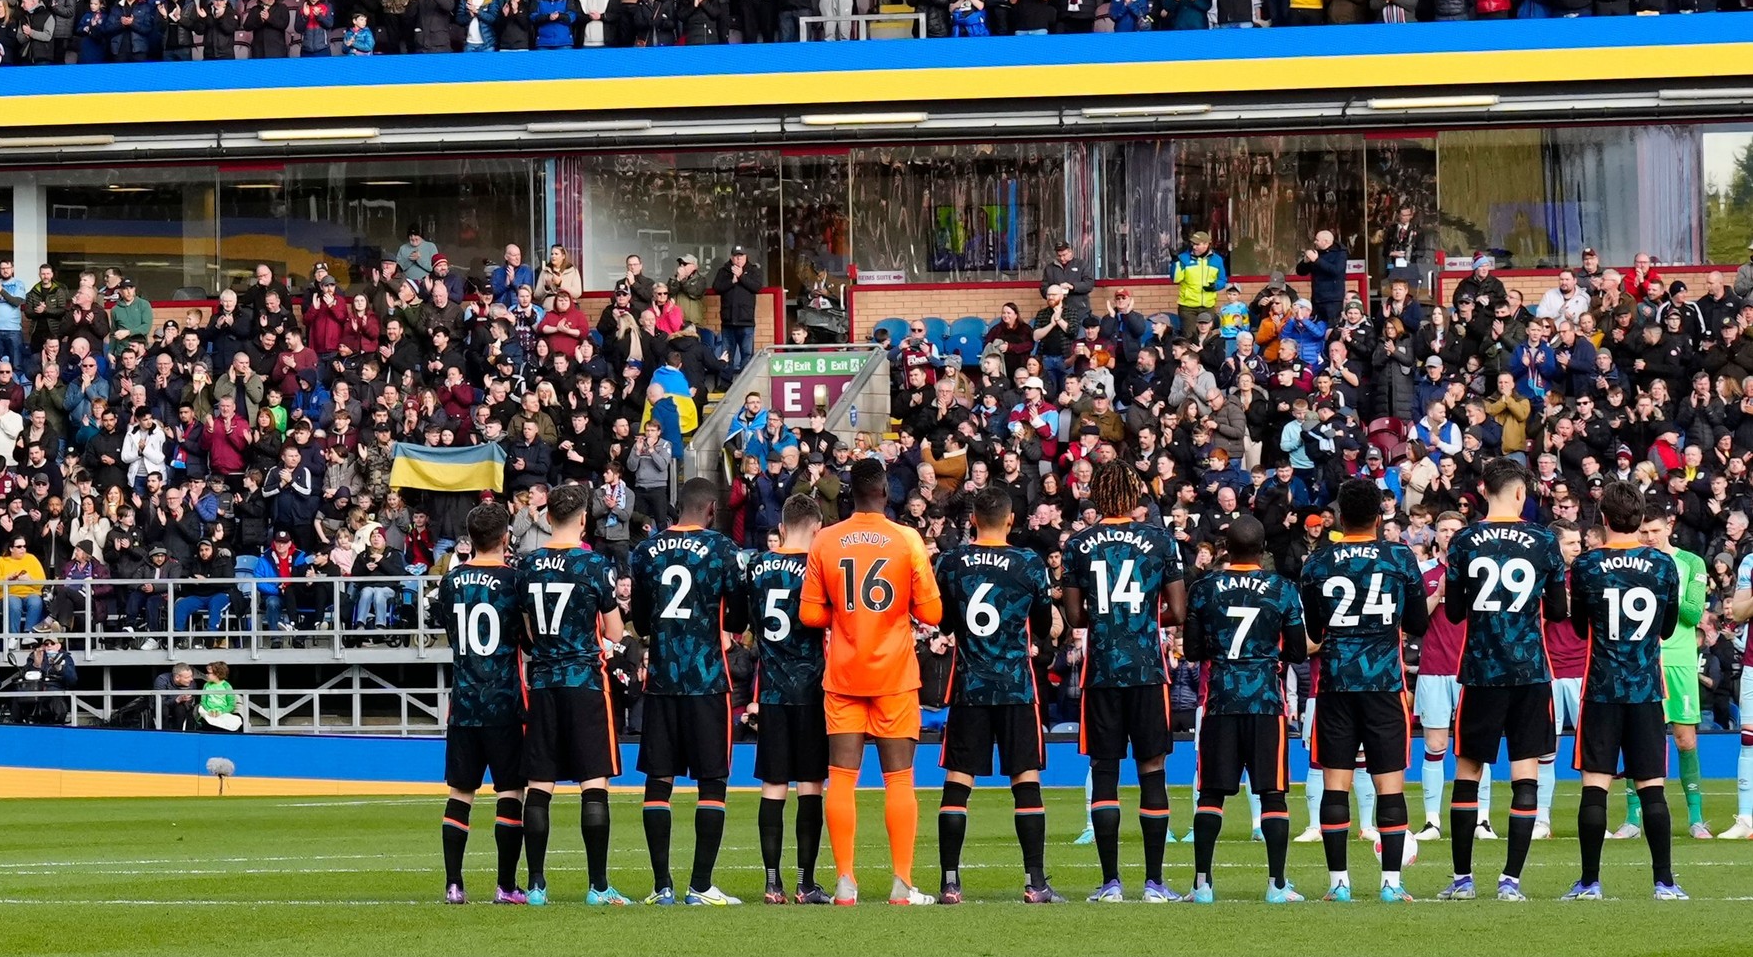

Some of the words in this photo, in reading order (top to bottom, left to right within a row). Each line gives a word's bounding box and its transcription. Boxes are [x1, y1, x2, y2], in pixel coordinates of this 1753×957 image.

[795, 361, 811, 371] Exit
[816, 359, 826, 373] 8
[831, 360, 848, 370] Exit
[783, 382, 801, 412] E
[648, 538, 709, 559] RÜDIGER
[840, 532, 890, 549] MENDY
[1079, 530, 1154, 555] CHALOBAH
[1333, 547, 1380, 563] JAMES
[1470, 528, 1536, 549] HAVERTZ
[453, 572, 501, 591] PULISIC
[535, 555, 566, 572] SAÚL
[1468, 556, 1536, 613] 29
[1599, 556, 1653, 573] MOUNT
[660, 565, 693, 620] 2
[838, 558, 895, 612] 16
[1089, 559, 1145, 615] 14
[1216, 577, 1270, 595] KANTÉ
[1322, 572, 1397, 627] 24
[453, 602, 501, 657] 10
[528, 582, 575, 636] 17
[763, 588, 791, 642] 5
[965, 582, 1000, 637] 6
[1602, 587, 1657, 641] 19
[1226, 606, 1260, 660] 7
